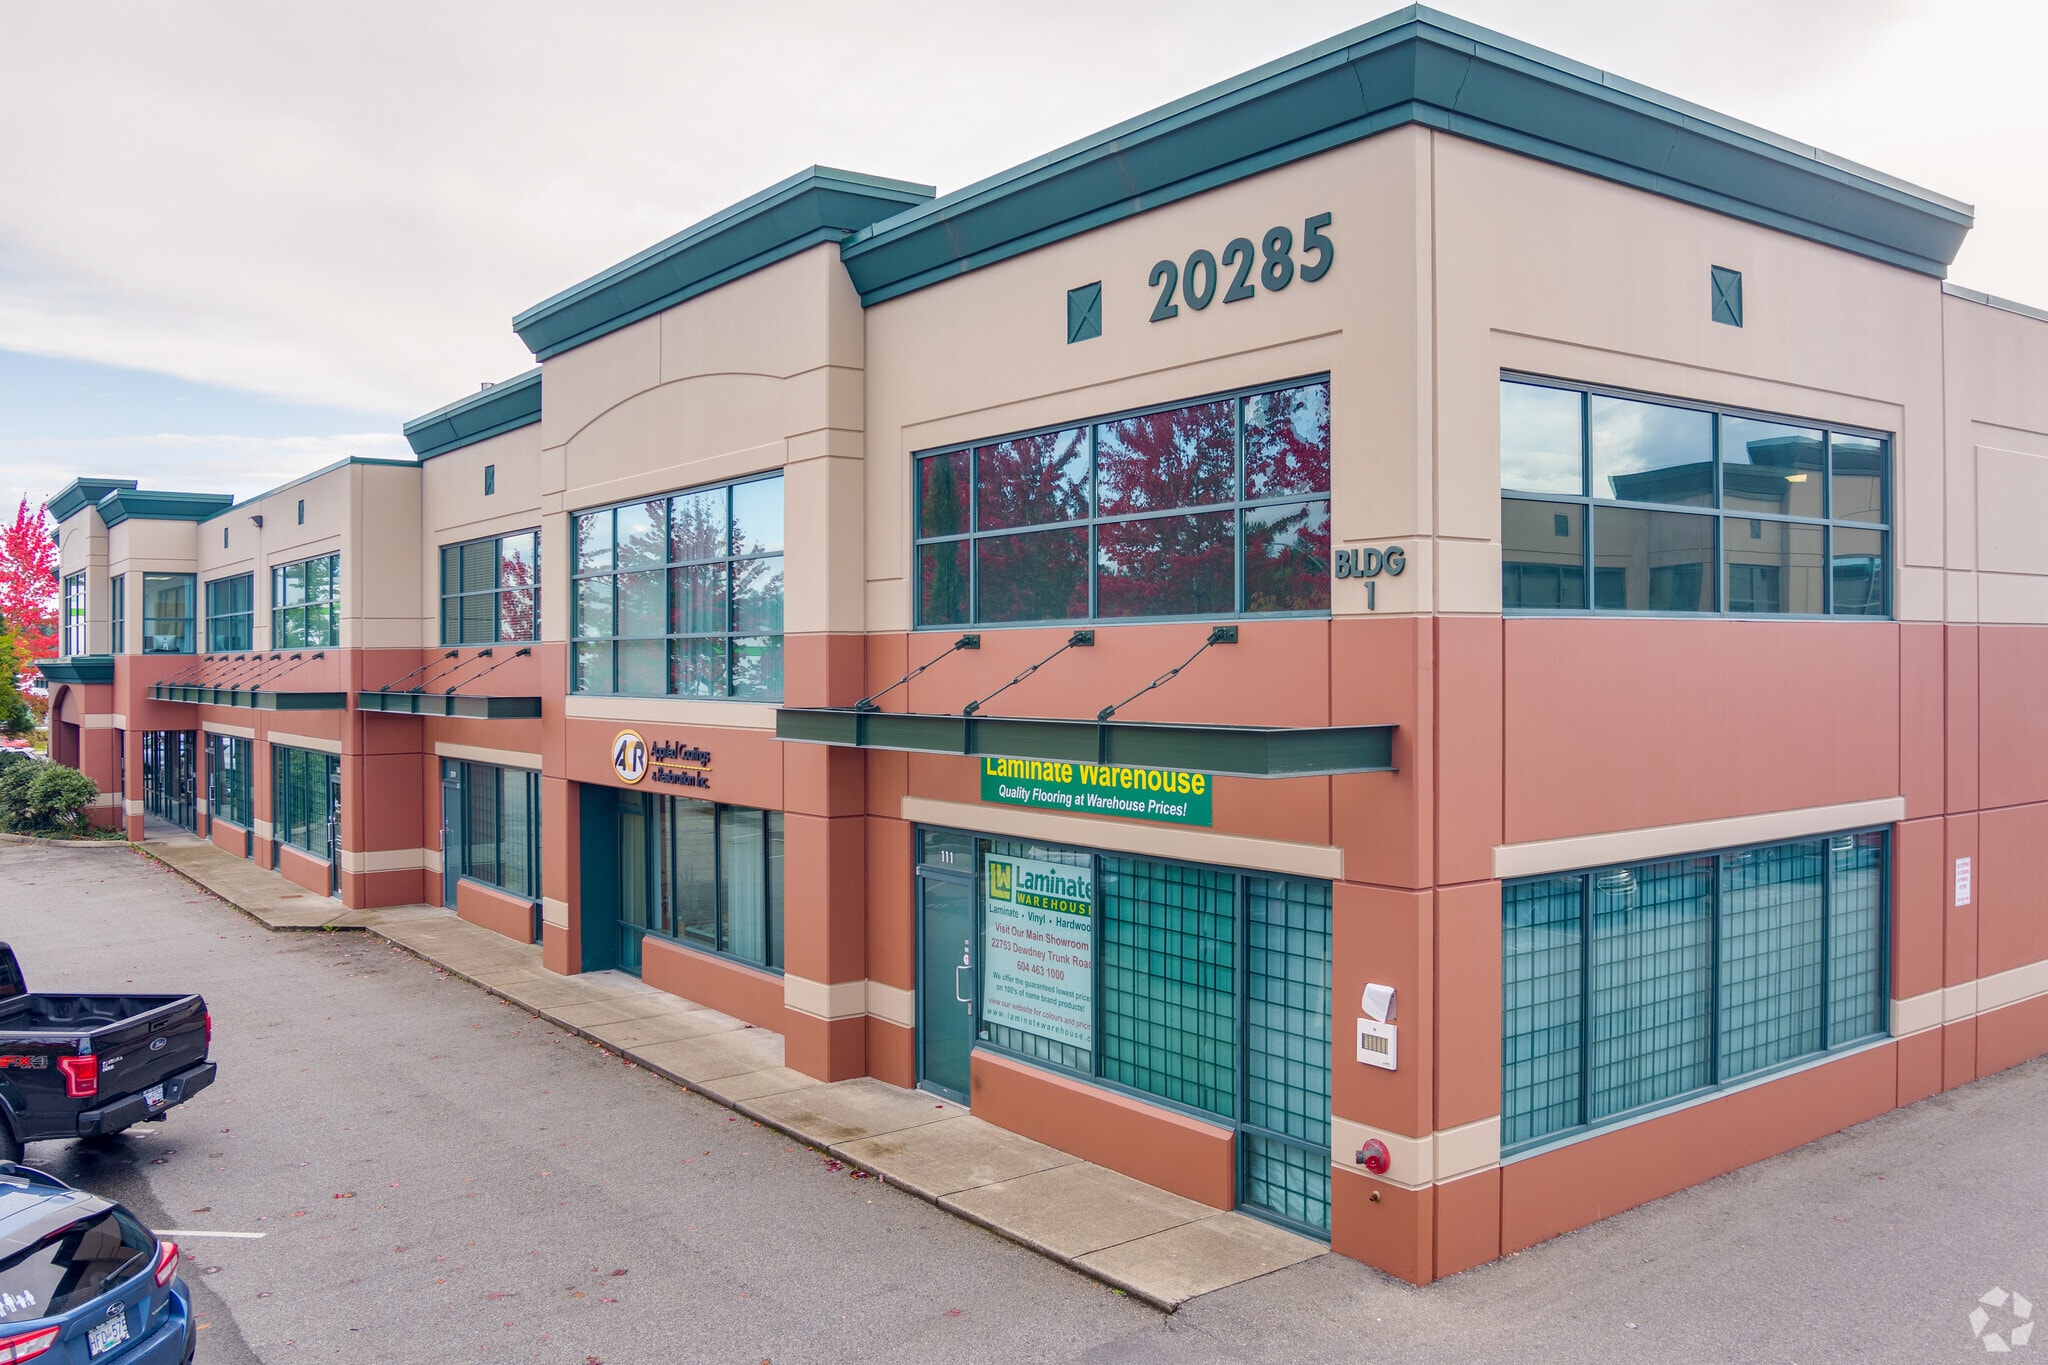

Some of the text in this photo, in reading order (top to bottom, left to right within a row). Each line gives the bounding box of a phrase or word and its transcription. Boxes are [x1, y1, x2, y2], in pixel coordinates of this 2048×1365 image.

[1148, 211, 1335, 323] 20285
[1335, 546, 1406, 579] BLDG
[1364, 581, 1375, 610] 1
[650, 740, 711, 767] Applied Coatings
[658, 767, 696, 786] Restoration
[697, 771, 711, 789] Inc.
[986, 757, 1206, 795] Laminate Warehouse
[998, 784, 1188, 817] Quality Flooring at Warehouse Prices!
[941, 850, 953, 864] 111
[989, 903, 1019, 919] Laminate
[1028, 911, 1045, 925] Vinyl
[995, 922, 1089, 951] Visit Our Main Showroom
[991, 938, 1011, 951] 22753
[1013, 942, 1045, 961] Dewdney
[1048, 950, 1070, 965] Trunk
[993, 970, 1001, 980] We
[1002, 974, 1014, 983] offer
[1015, 976, 1023, 985] the
[1025, 979, 1055, 994] guaranteed
[1056, 986, 1074, 998] lowest
[1017, 961, 1064, 981] 604 463 1000
[1018, 988, 1024, 997] of
[1025, 991, 1040, 1001] name
[1041, 994, 1057, 1005] brand
[1001, 1000, 1011, 1008] our
[1012, 1002, 1032, 1015] website
[1033, 1008, 1041, 1017] for
[1043, 1010, 1063, 1023] colours
[1064, 1016, 1075, 1026] and
